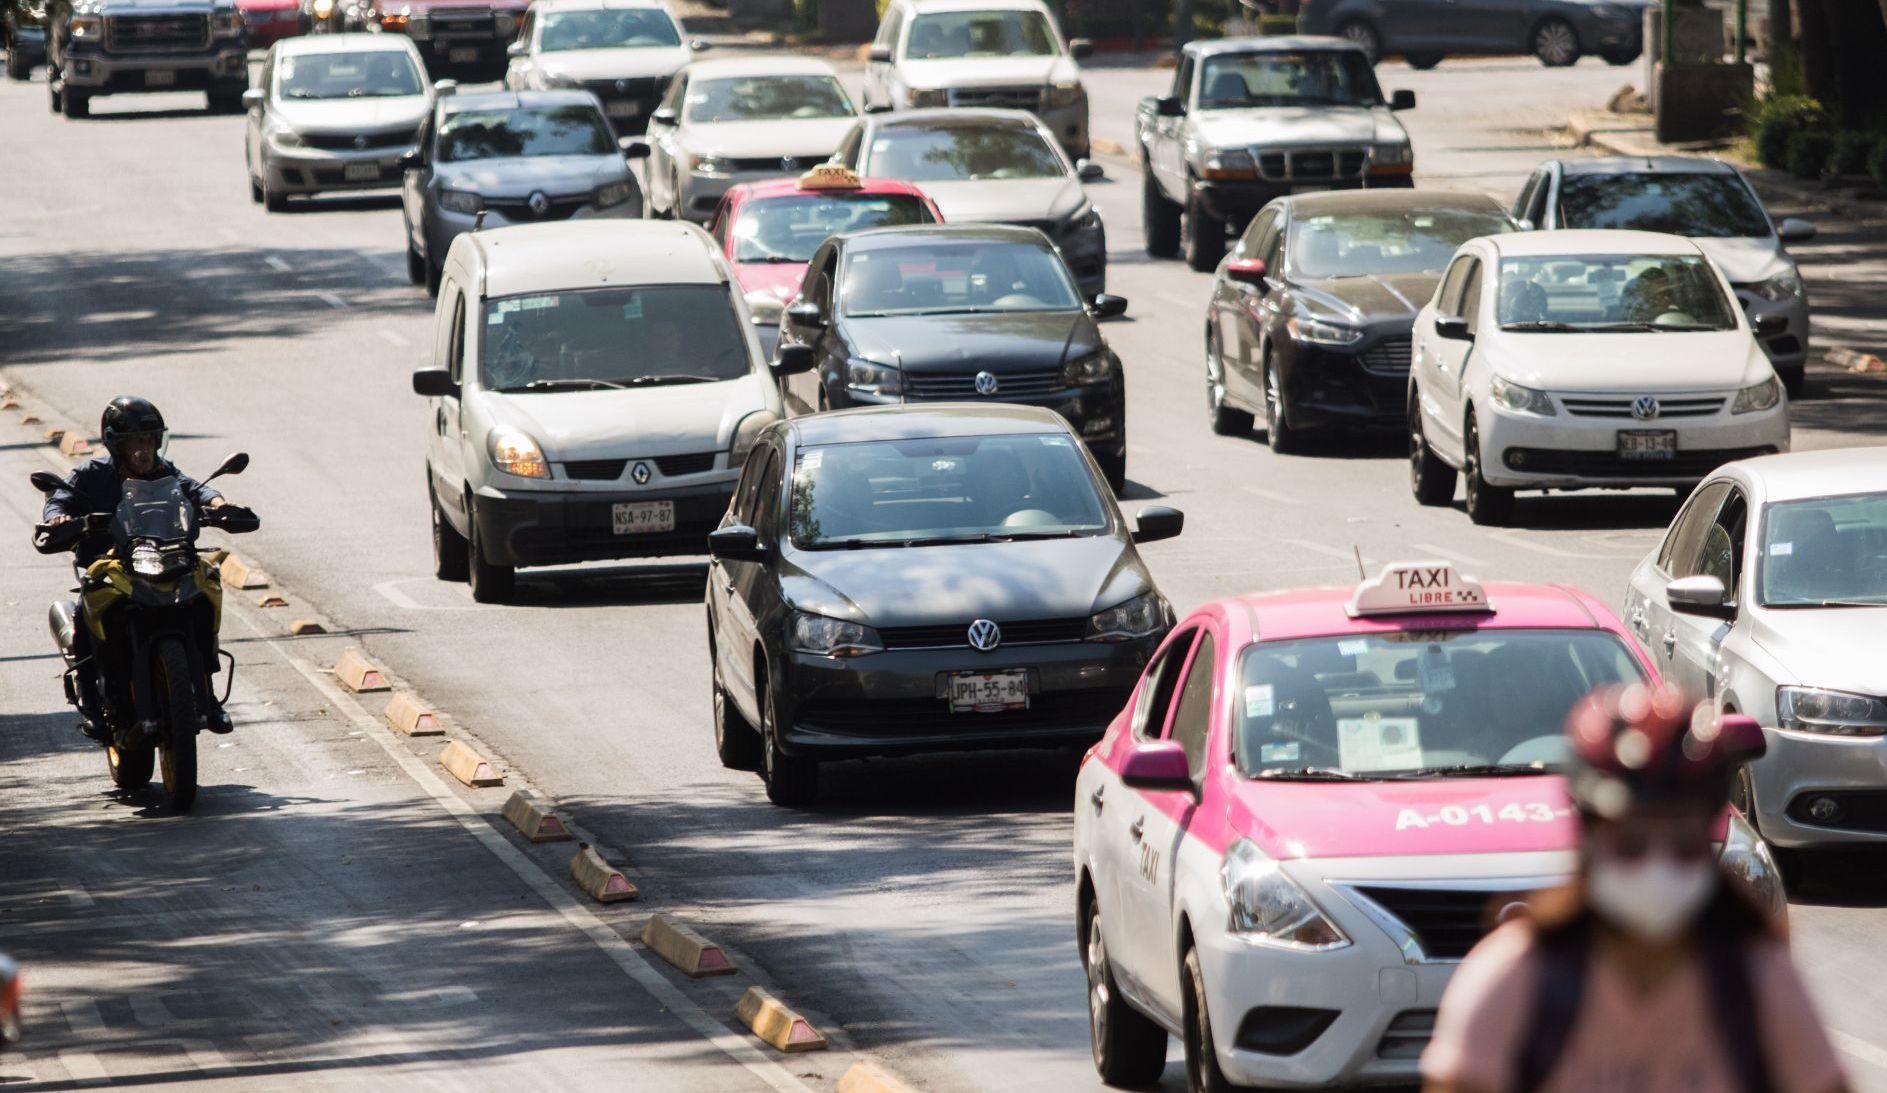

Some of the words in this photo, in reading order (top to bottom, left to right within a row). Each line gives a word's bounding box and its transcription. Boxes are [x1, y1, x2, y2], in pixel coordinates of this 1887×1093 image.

[818, 168, 845, 177] TAXI
[615, 509, 672, 525] NSA-97-87
[1393, 568, 1448, 589] TAXI
[1410, 592, 1452, 604] LIBRE
[1396, 802, 1577, 831] A-0143-
[1141, 842, 1159, 886] TAXI
